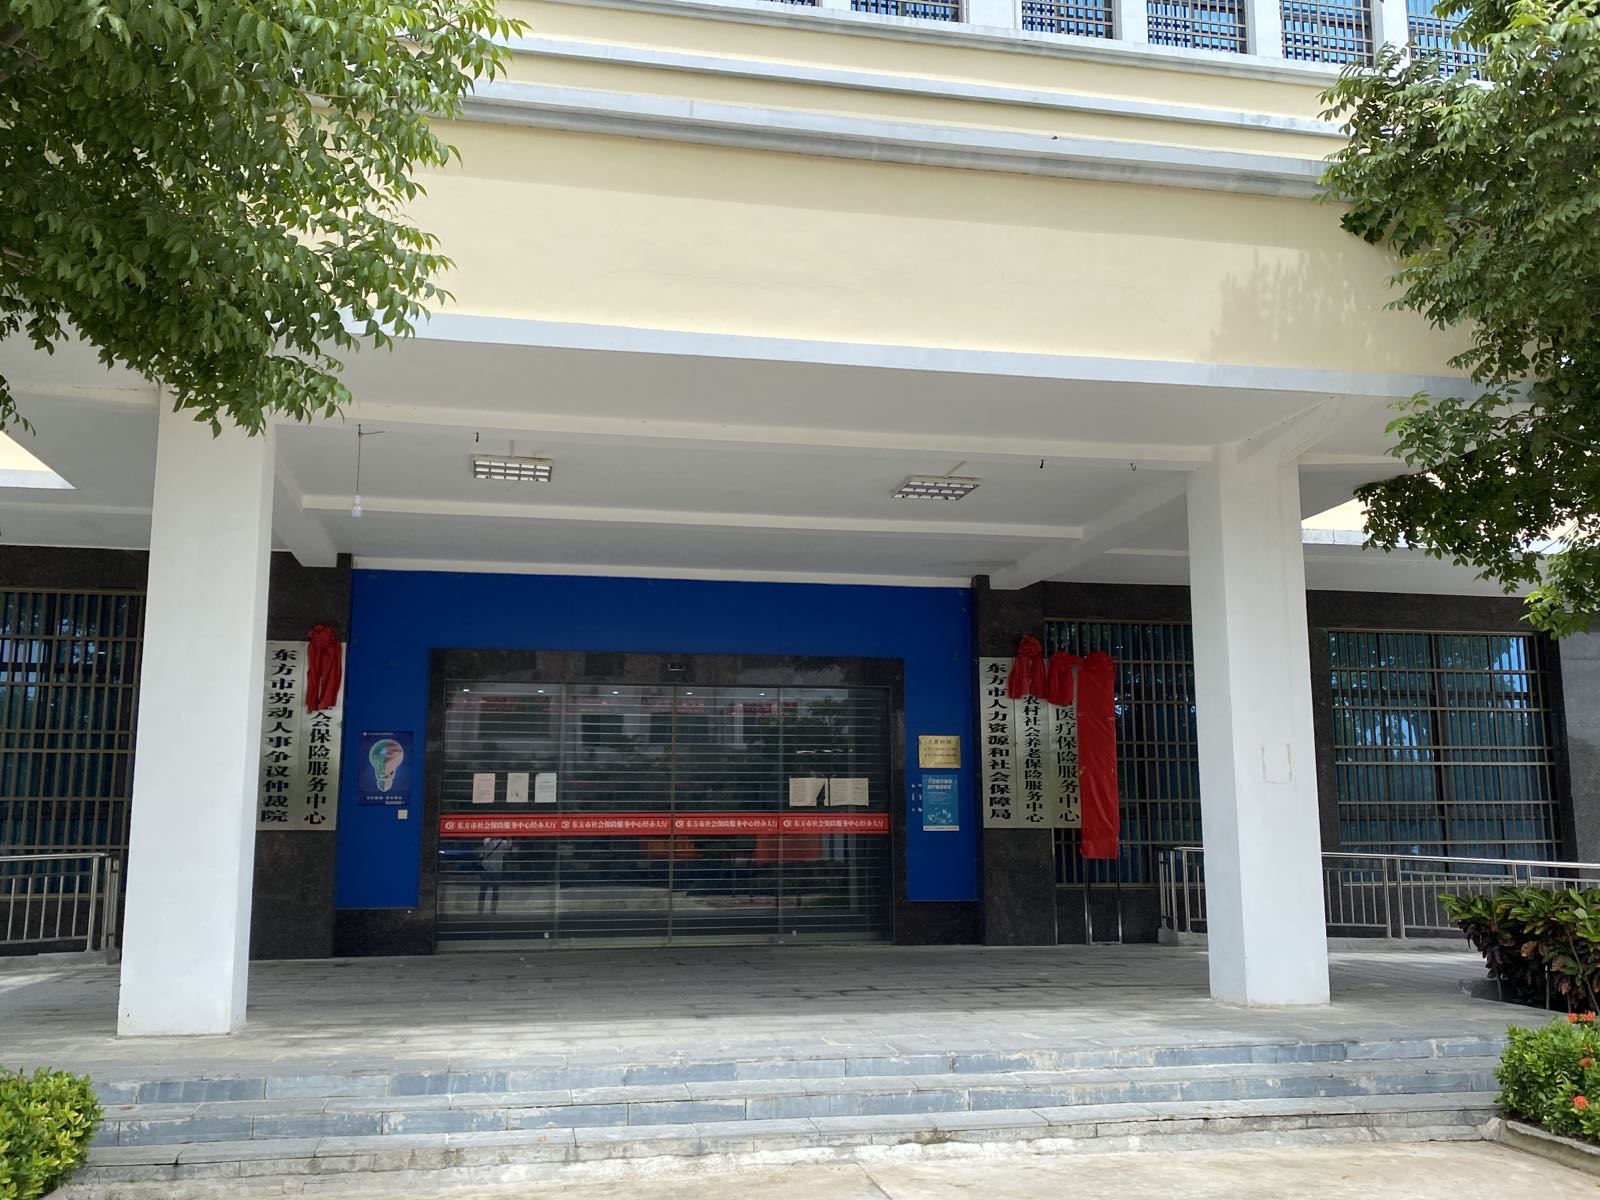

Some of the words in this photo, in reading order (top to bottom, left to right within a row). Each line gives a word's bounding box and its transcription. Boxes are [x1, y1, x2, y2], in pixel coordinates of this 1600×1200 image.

[260, 648, 297, 823] 东方市劳动人事争议仲裁院
[304, 707, 333, 825] 会保险服务中心
[986, 662, 1012, 820] 东方市人力资源和社会保障局
